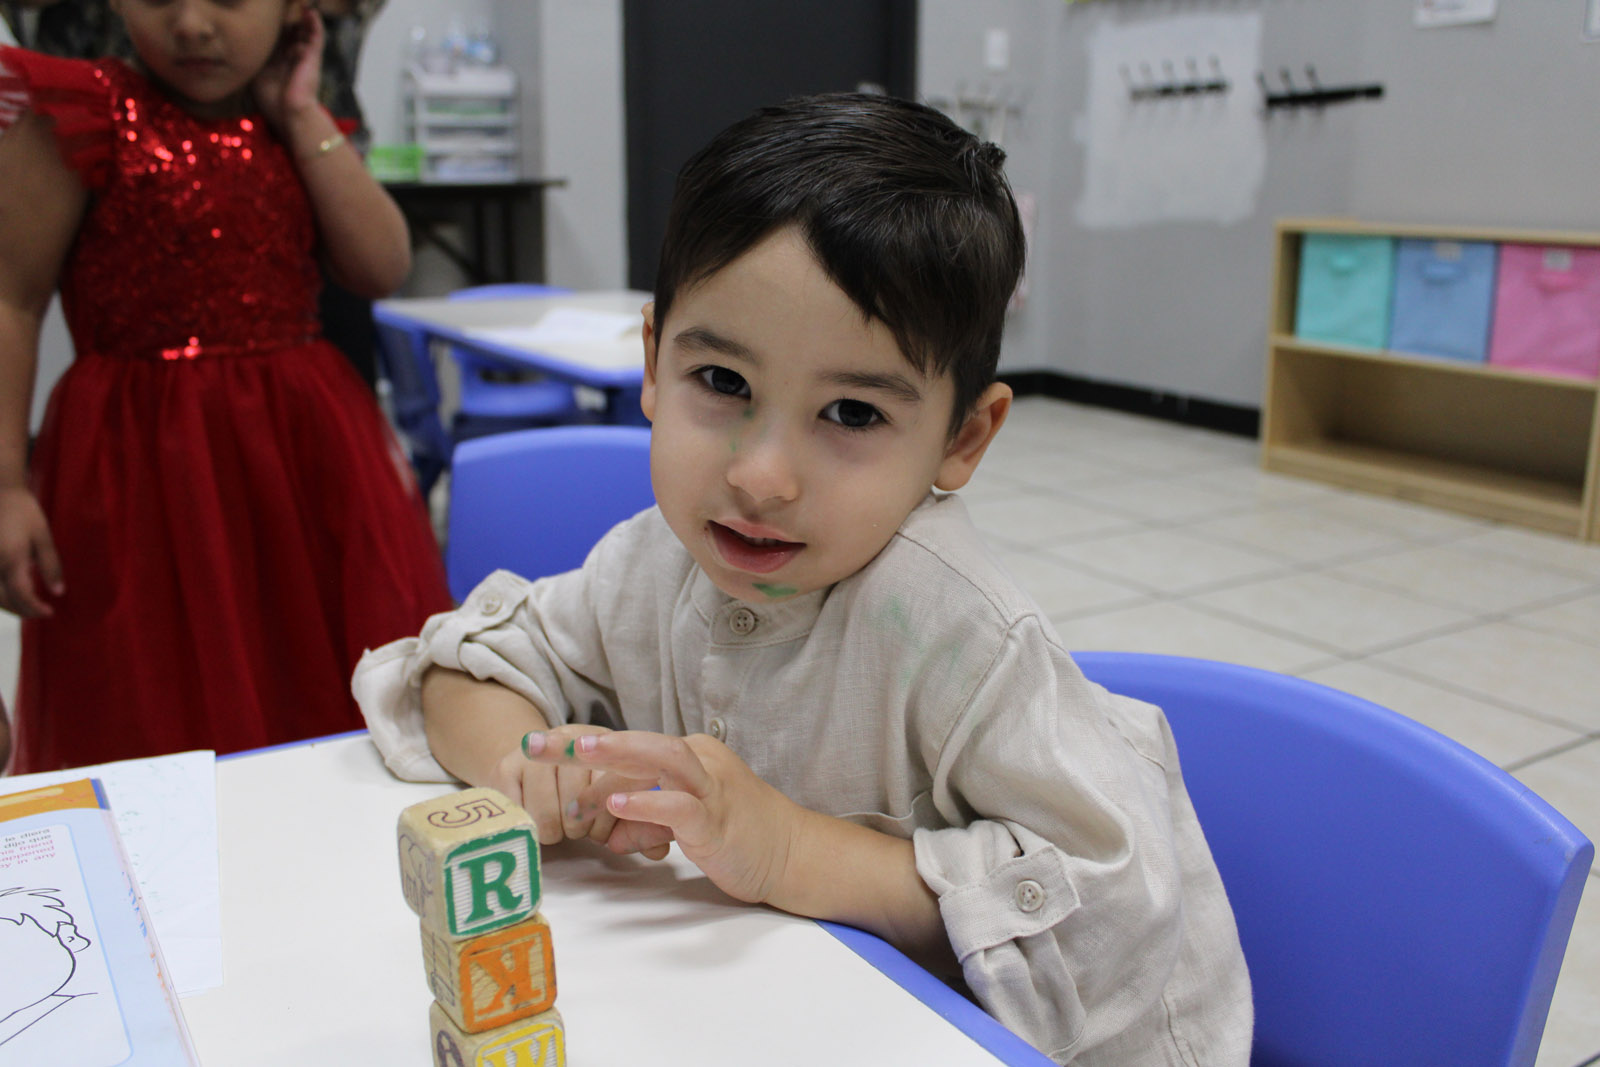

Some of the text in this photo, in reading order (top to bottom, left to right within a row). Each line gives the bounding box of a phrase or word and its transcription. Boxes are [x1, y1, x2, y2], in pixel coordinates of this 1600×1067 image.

[427, 798, 506, 829] 5
[0, 845, 55, 862] appened
[19, 839, 53, 851] friend
[34, 852, 56, 861] any
[459, 851, 523, 924] R
